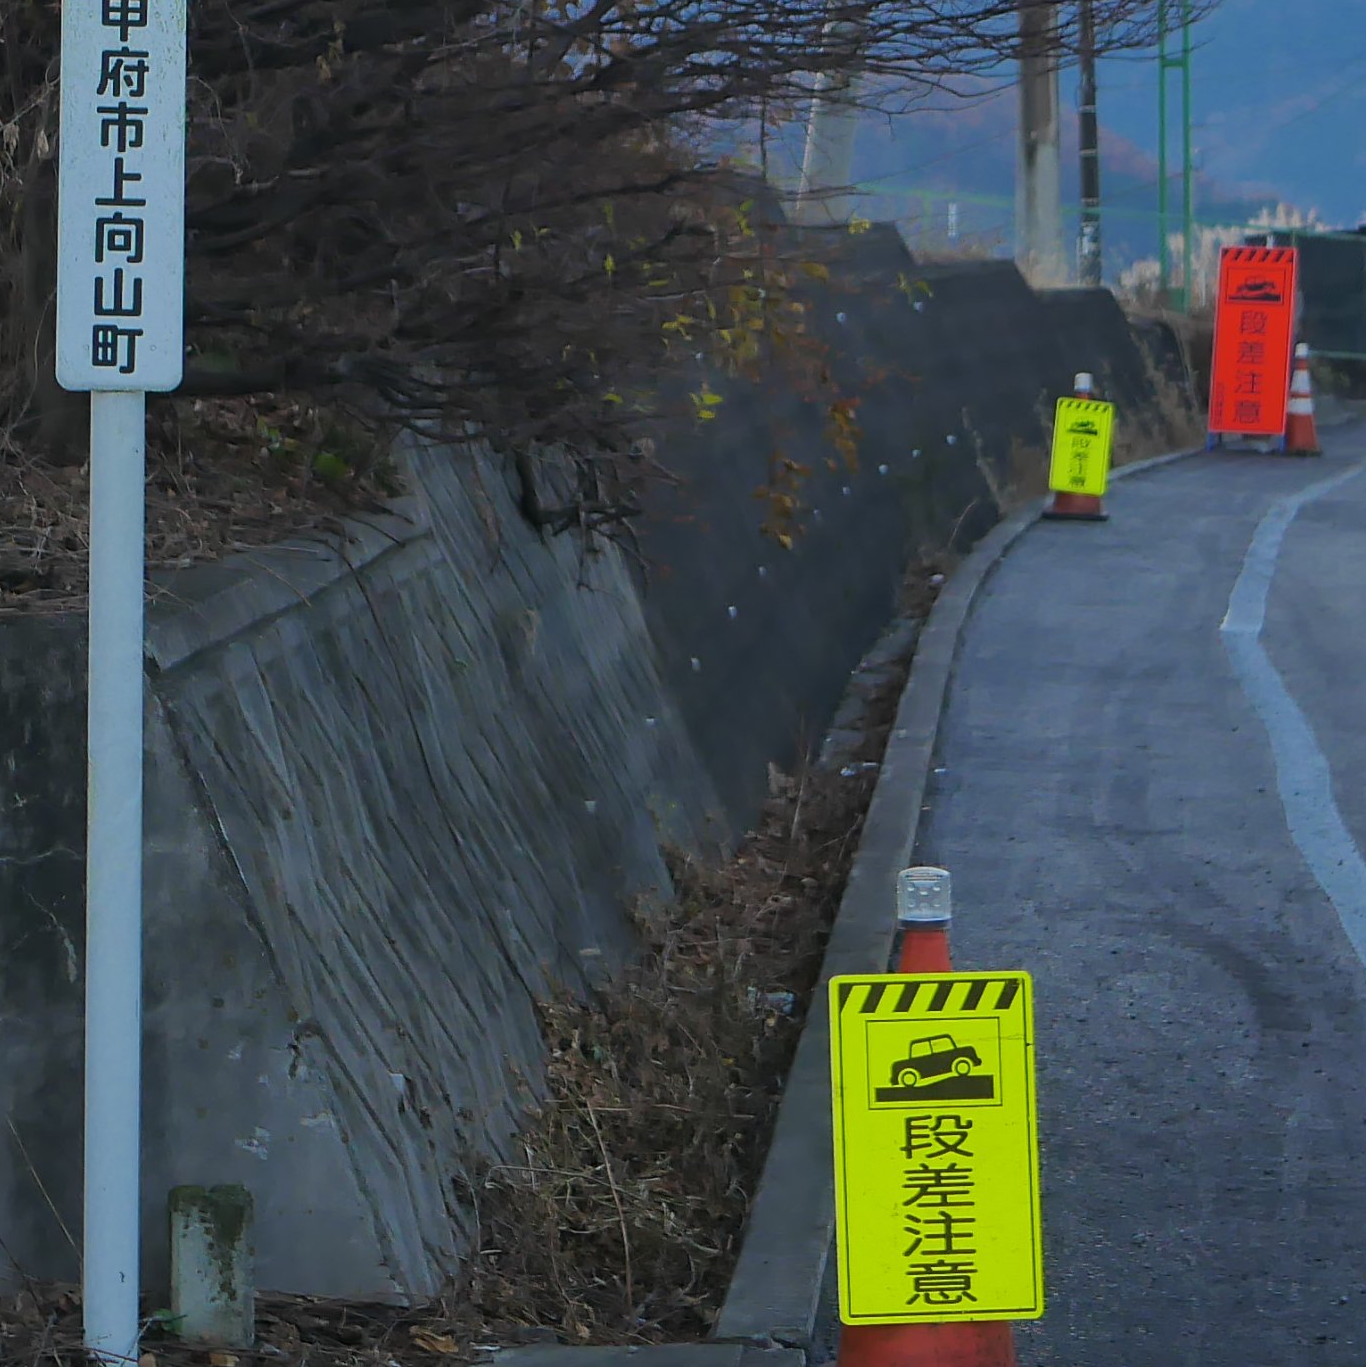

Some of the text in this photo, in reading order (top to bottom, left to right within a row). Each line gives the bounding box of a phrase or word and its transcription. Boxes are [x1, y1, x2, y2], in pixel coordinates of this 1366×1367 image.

[1232, 309, 1268, 424] 段差注意
[899, 1114, 979, 1306] 段差注意
